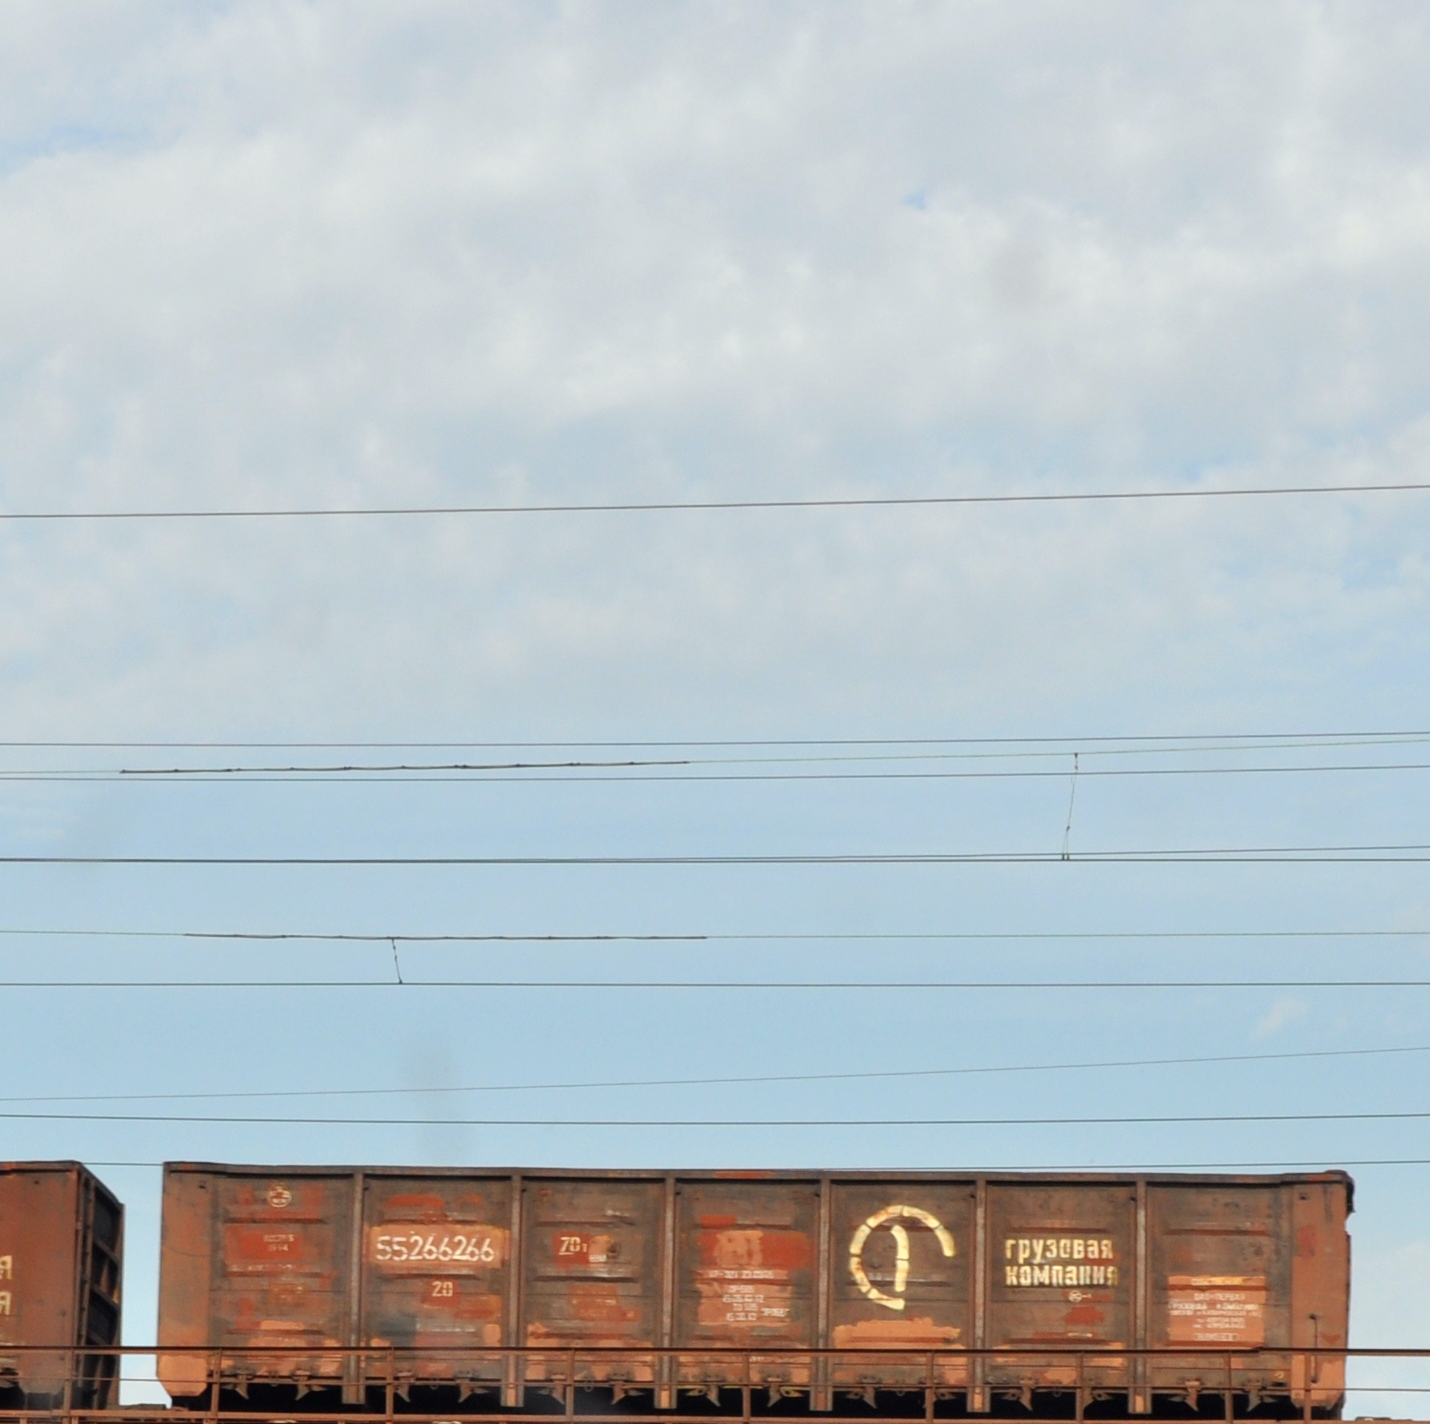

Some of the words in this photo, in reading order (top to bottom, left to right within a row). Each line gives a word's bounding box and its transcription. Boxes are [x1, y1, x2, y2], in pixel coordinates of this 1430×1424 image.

[376, 1235, 494, 1261] 55266266
[1005, 1239, 1113, 1264] грузовая
[1005, 1265, 1118, 1287] компания
[432, 1281, 453, 1297] 20
